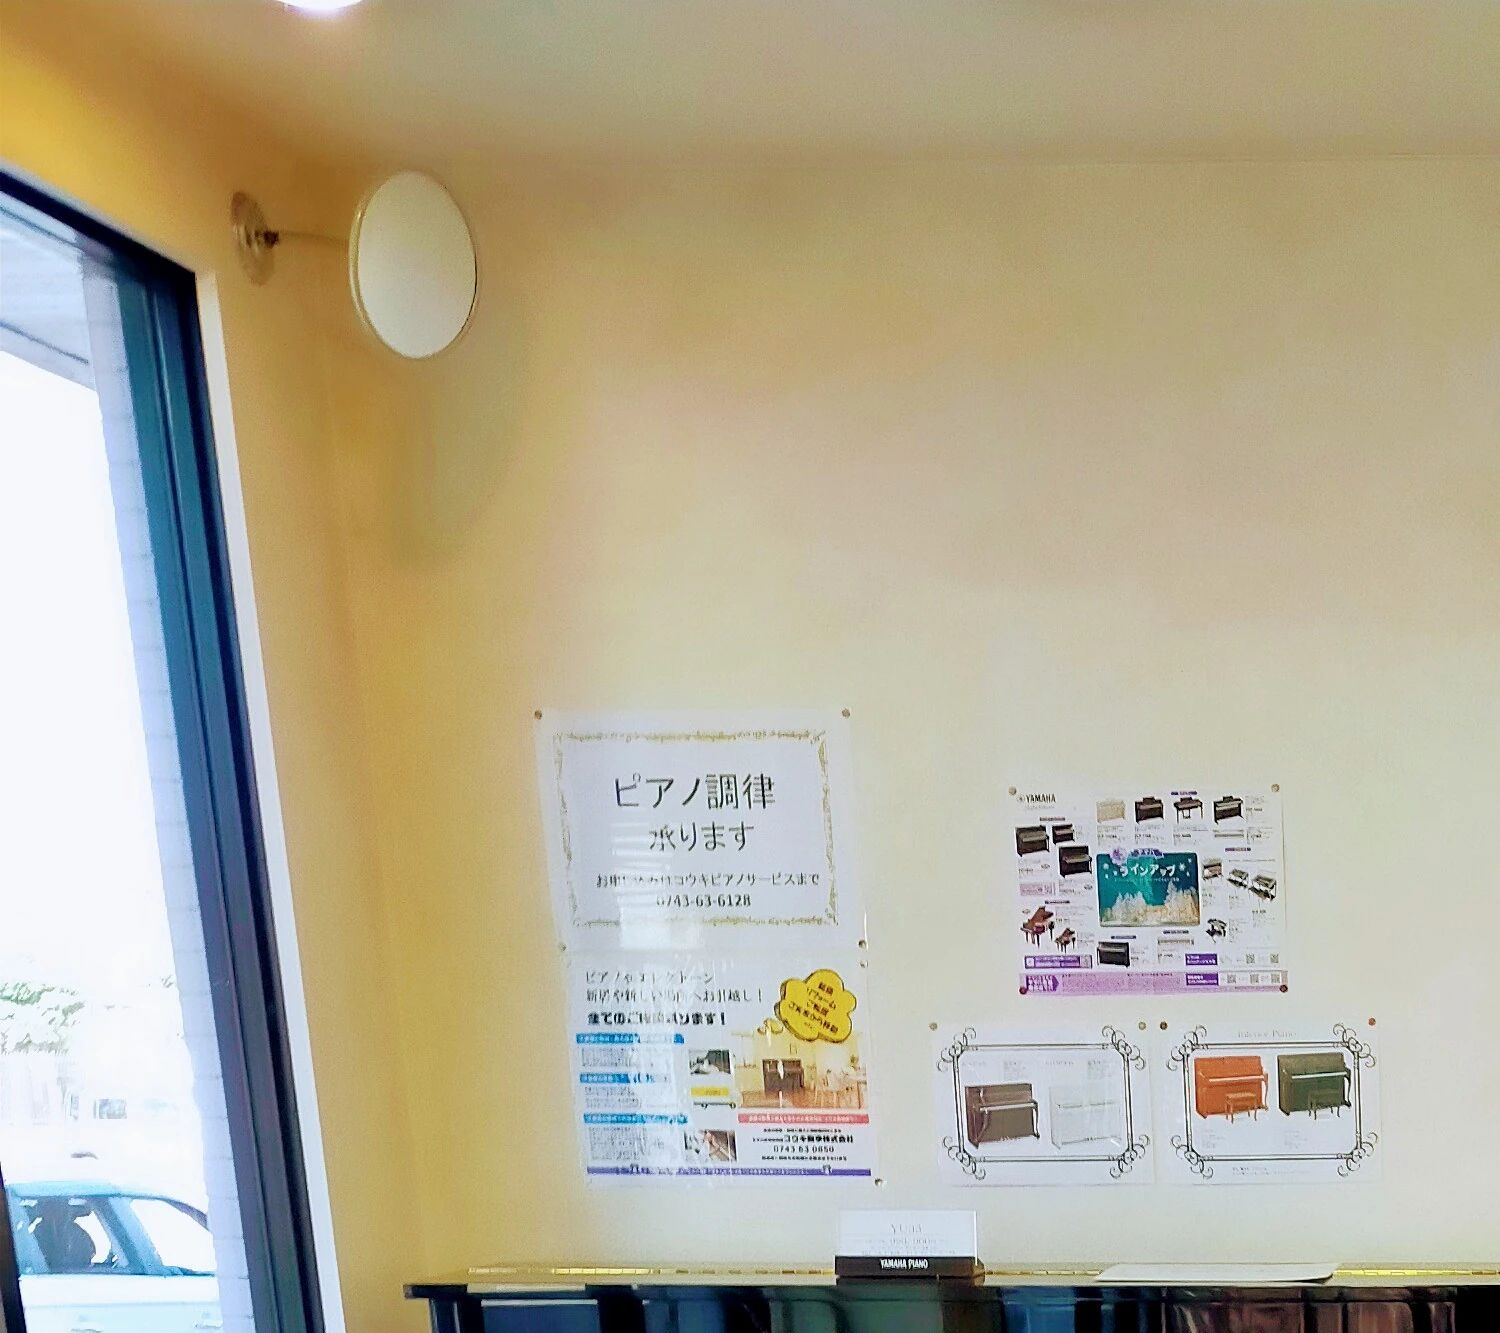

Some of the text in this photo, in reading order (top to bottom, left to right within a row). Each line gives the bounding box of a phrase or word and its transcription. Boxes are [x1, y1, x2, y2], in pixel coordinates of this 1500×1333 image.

[615, 772, 776, 810] ピアノ調律
[1026, 794, 1056, 803] YAMAHA
[649, 821, 755, 851] 承ります
[1120, 863, 1176, 877] ラインアップ
[880, 1258, 929, 1270] YAMAHA PIANO
